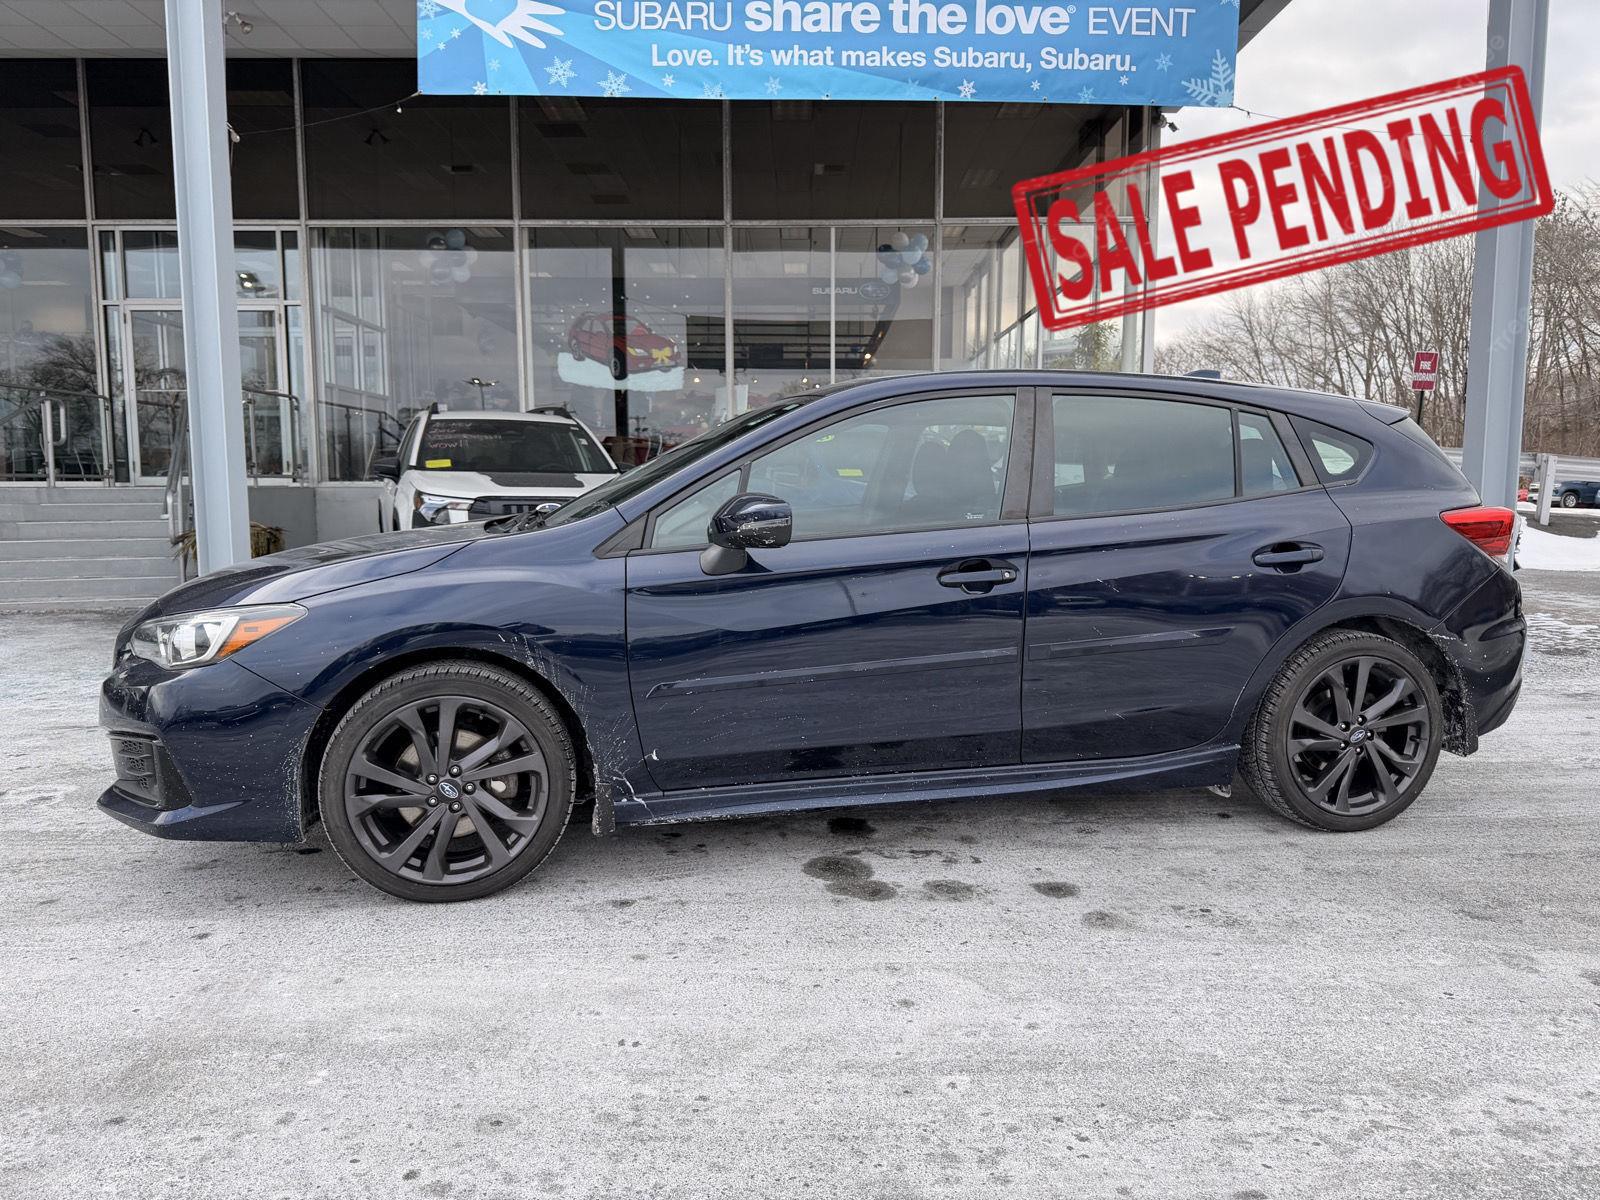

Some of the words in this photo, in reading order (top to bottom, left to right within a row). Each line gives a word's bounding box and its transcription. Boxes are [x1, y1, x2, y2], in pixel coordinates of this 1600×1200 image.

[593, 1, 732, 31] SUBARU
[744, 0, 880, 33] share
[890, 0, 967, 35] the
[1088, 7, 1196, 37] EVENT
[651, 44, 719, 67] Love.
[771, 44, 834, 67] what
[841, 45, 926, 68] makes
[933, 46, 1032, 73] Subaru,
[1039, 47, 1137, 72] Subaru.
